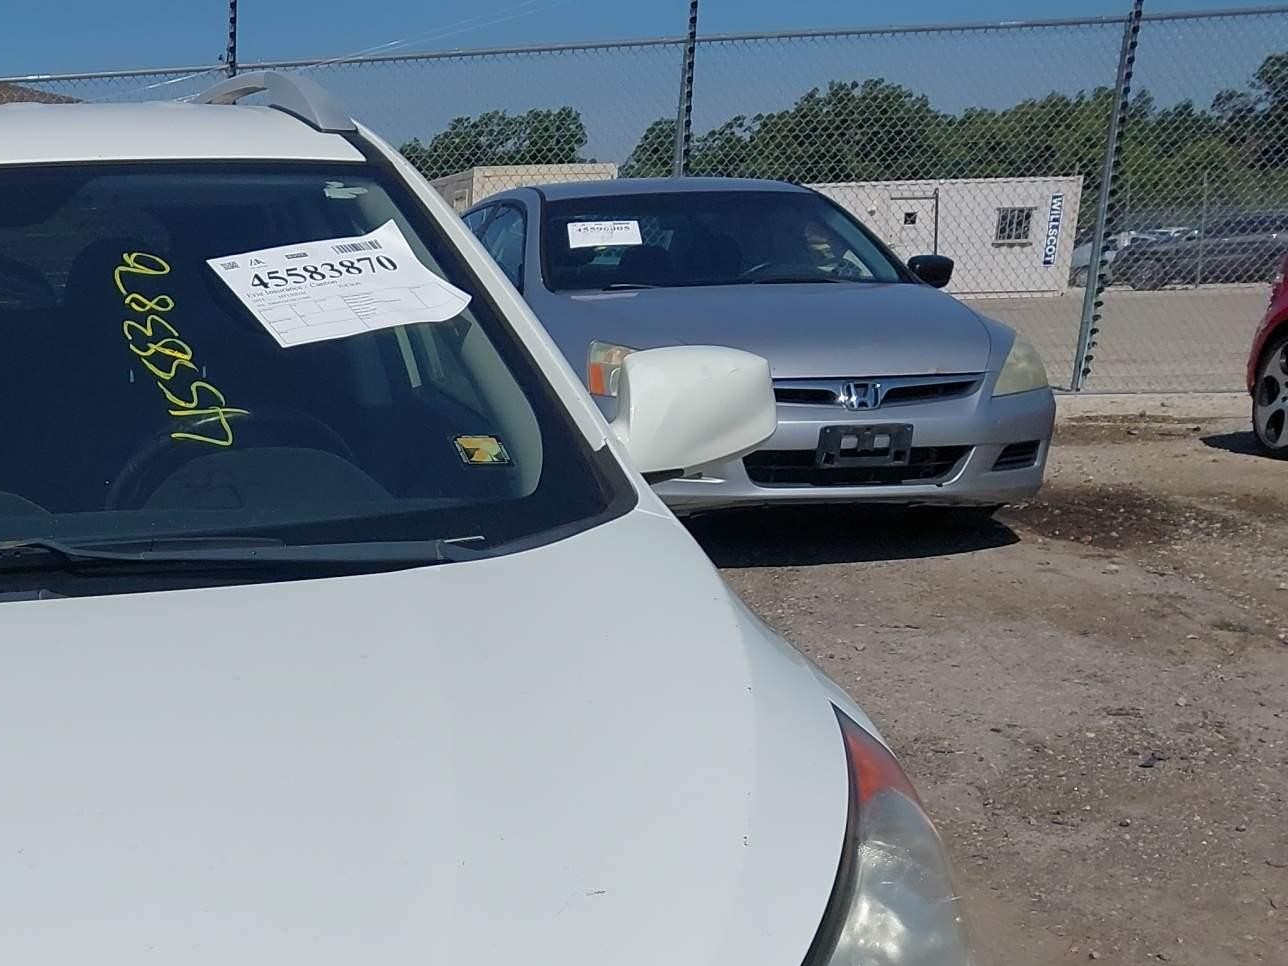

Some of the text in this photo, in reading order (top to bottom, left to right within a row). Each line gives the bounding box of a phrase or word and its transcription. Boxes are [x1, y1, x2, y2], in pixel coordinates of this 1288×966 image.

[1045, 197, 1063, 263] WILLSCOT
[251, 255, 398, 289] 45583870
[114, 252, 251, 446] 45583870
